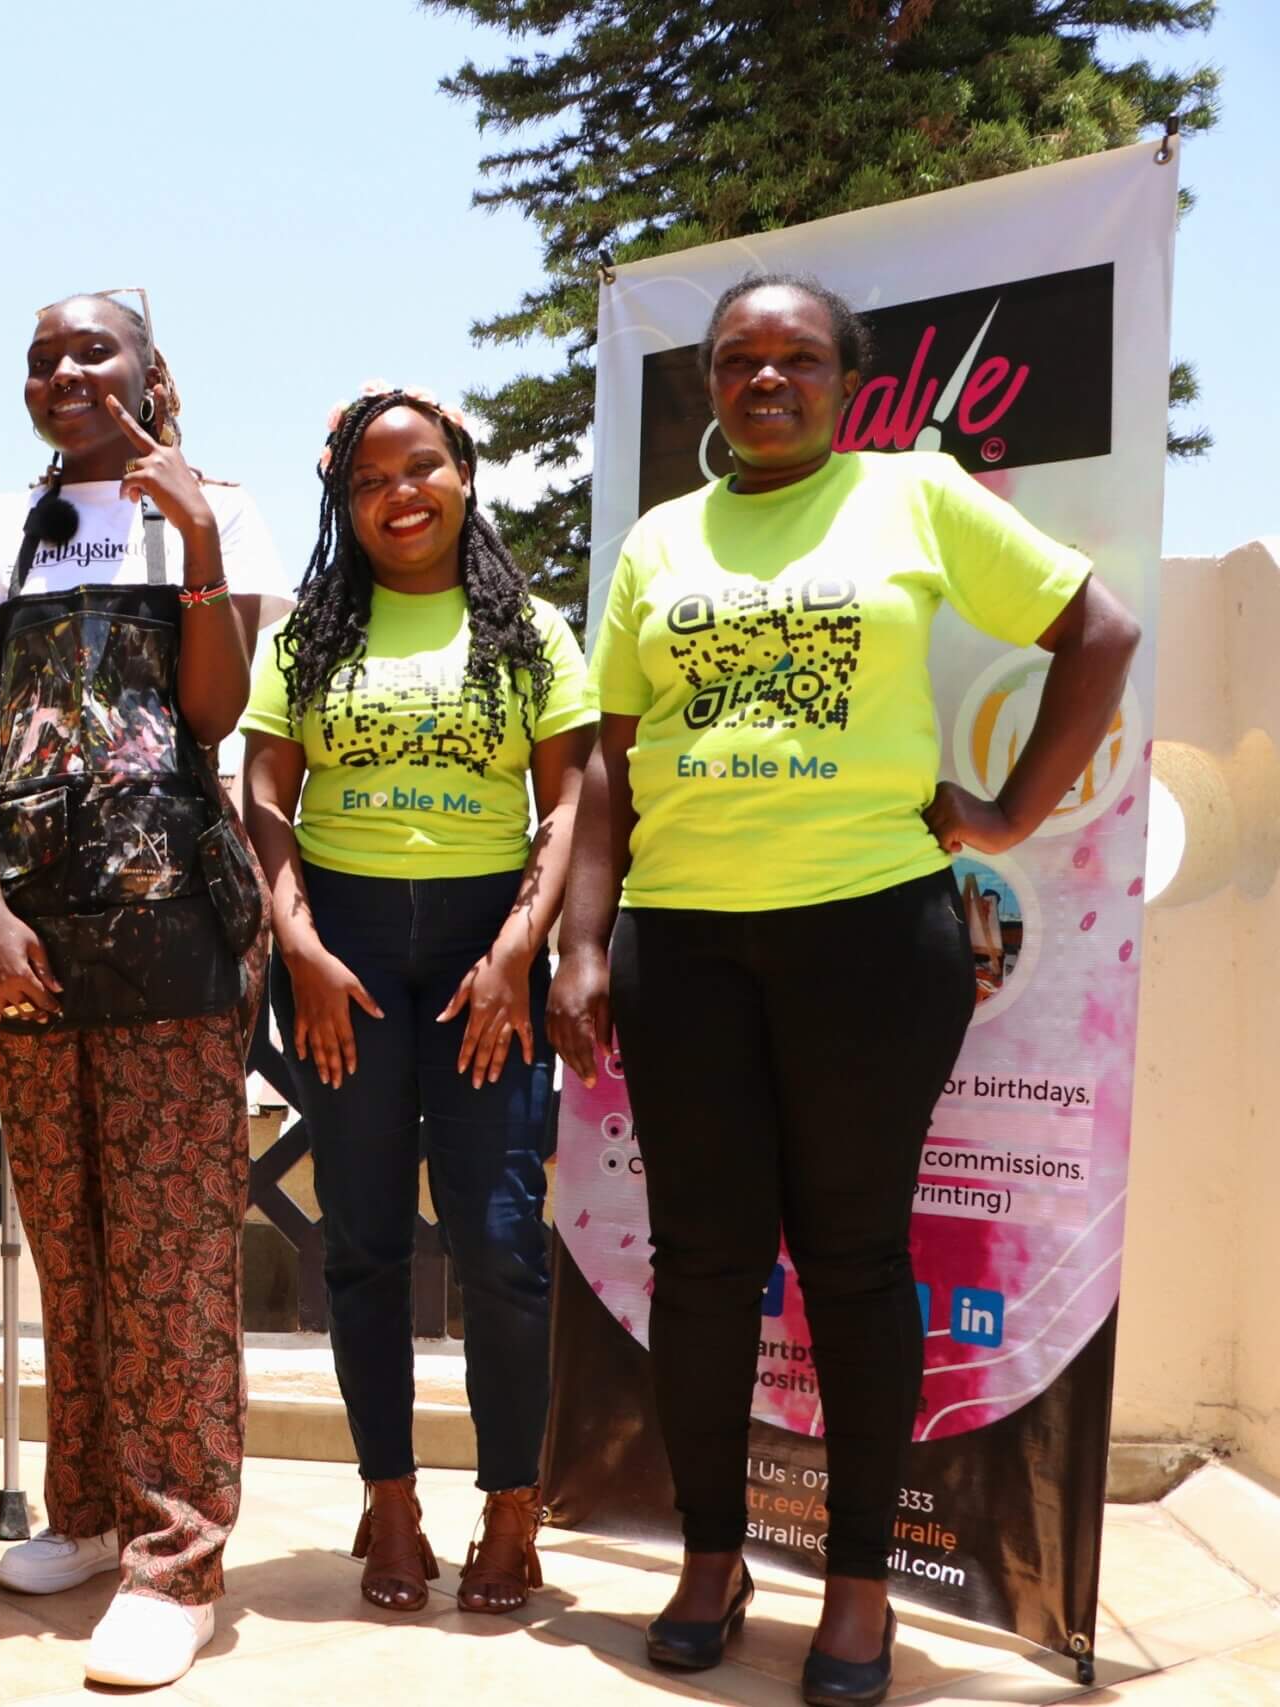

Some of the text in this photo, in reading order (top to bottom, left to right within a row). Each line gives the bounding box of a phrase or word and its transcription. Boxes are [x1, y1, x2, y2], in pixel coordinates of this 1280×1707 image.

[677, 753, 838, 779] Enable Me
[342, 786, 482, 814] Enable Me
[924, 1151, 1084, 1180] commissions.
[759, 1460, 786, 1483] Us
